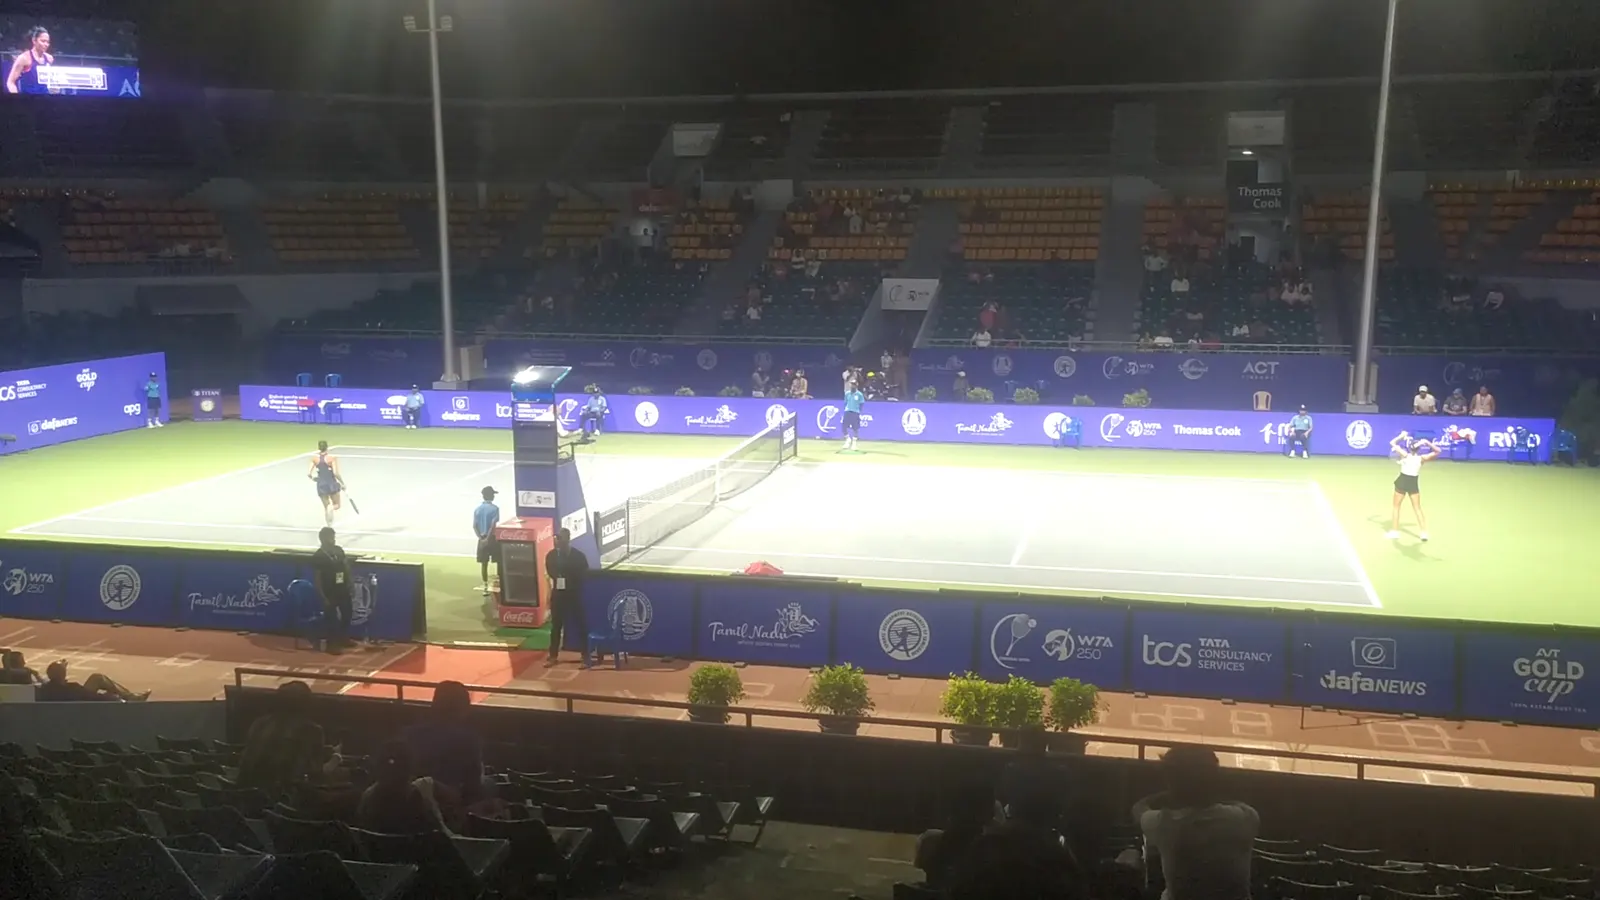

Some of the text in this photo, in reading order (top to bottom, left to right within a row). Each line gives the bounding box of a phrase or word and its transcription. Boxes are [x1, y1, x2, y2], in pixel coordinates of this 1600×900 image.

[1238, 187, 1282, 198] Thomas
[1253, 198, 1281, 209] Cook
[1242, 360, 1279, 374] ACT
[76, 372, 97, 383] GOLD
[80, 381, 95, 391] cup
[123, 402, 141, 415] apg
[1173, 424, 1241, 437] Thomas Cook
[602, 518, 625, 537] HOLOGIC
[29, 573, 54, 583] WTA
[27, 584, 45, 594] 250
[188, 592, 257, 610] Tamil Nadu
[708, 621, 790, 641] Tamil Nadu
[1077, 634, 1113, 648] WTA
[1198, 638, 1230, 648] TATA
[1076, 648, 1102, 660] 250
[1143, 634, 1192, 667] tcs
[1198, 648, 1272, 662] CONSULTANCY
[1535, 648, 1560, 658] AVT
[1198, 660, 1245, 672] SERVICES
[1513, 657, 1584, 680] GOLD
[1320, 670, 1427, 696] dafaNEWS
[1524, 678, 1574, 703] cup
